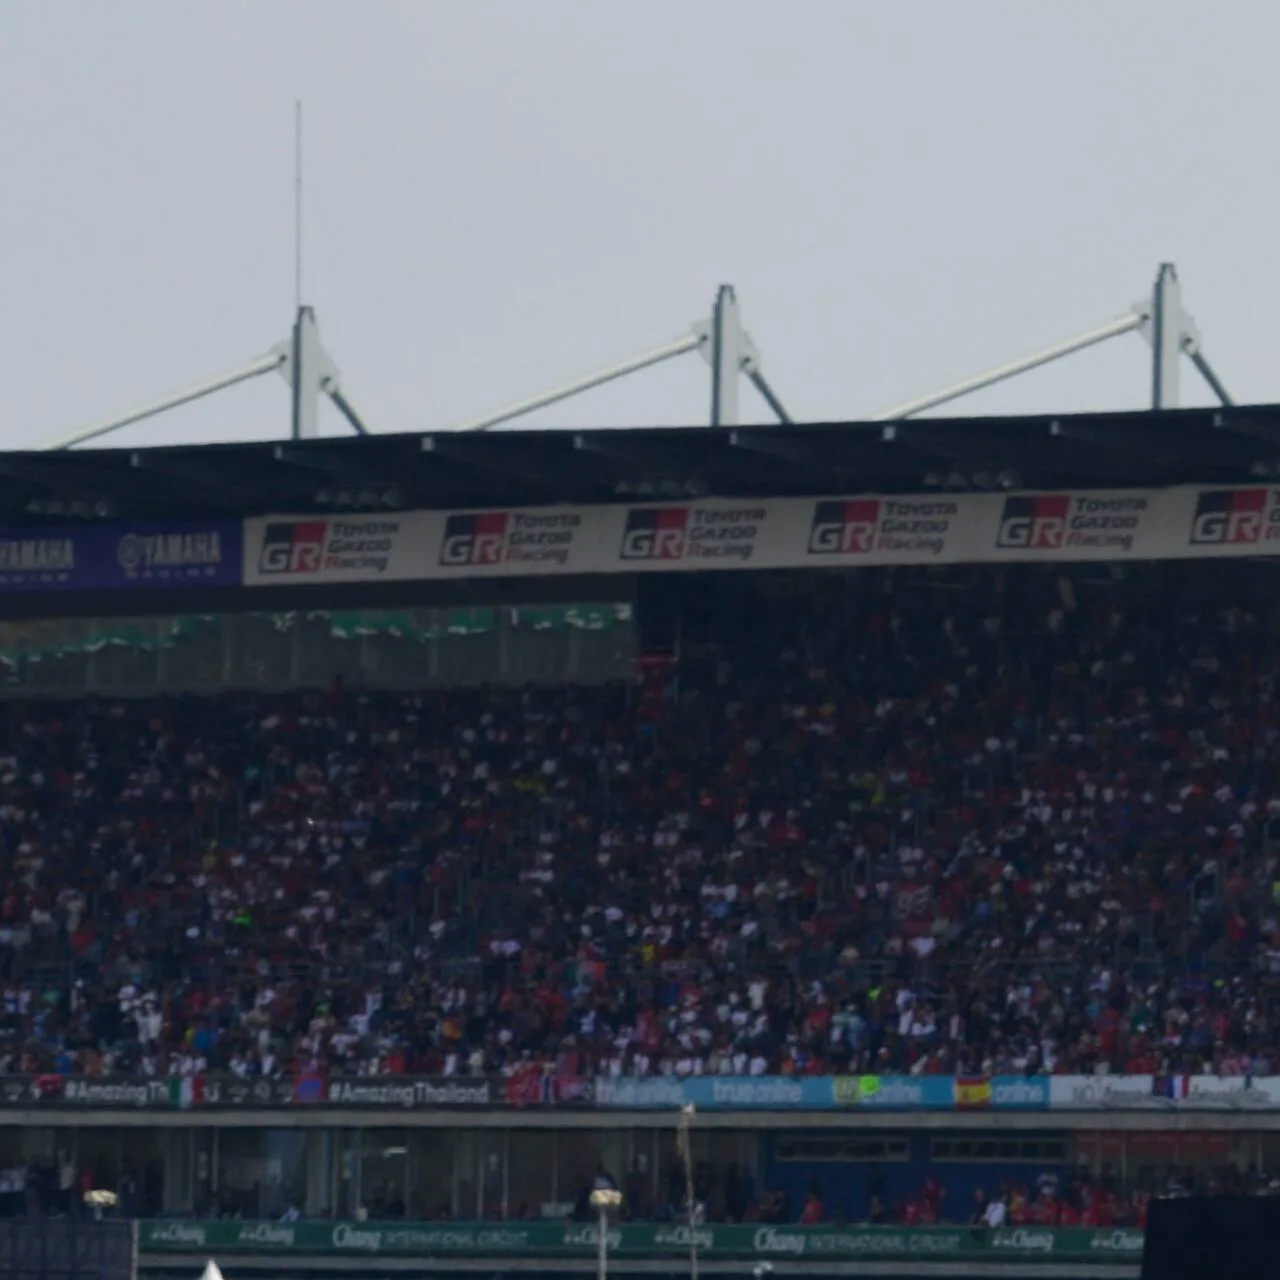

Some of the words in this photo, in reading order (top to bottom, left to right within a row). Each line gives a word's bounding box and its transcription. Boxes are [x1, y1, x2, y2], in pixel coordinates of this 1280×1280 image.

[808, 522, 873, 554] GR
[996, 517, 1063, 548] GR
[1190, 512, 1260, 543] GR
[259, 541, 321, 574] GR
[441, 534, 503, 565] GR
[622, 529, 682, 559] GR
[328, 1082, 488, 1107] #AmazingThailand
[332, 1223, 381, 1250] Chang
[754, 1228, 805, 1255] Chang
